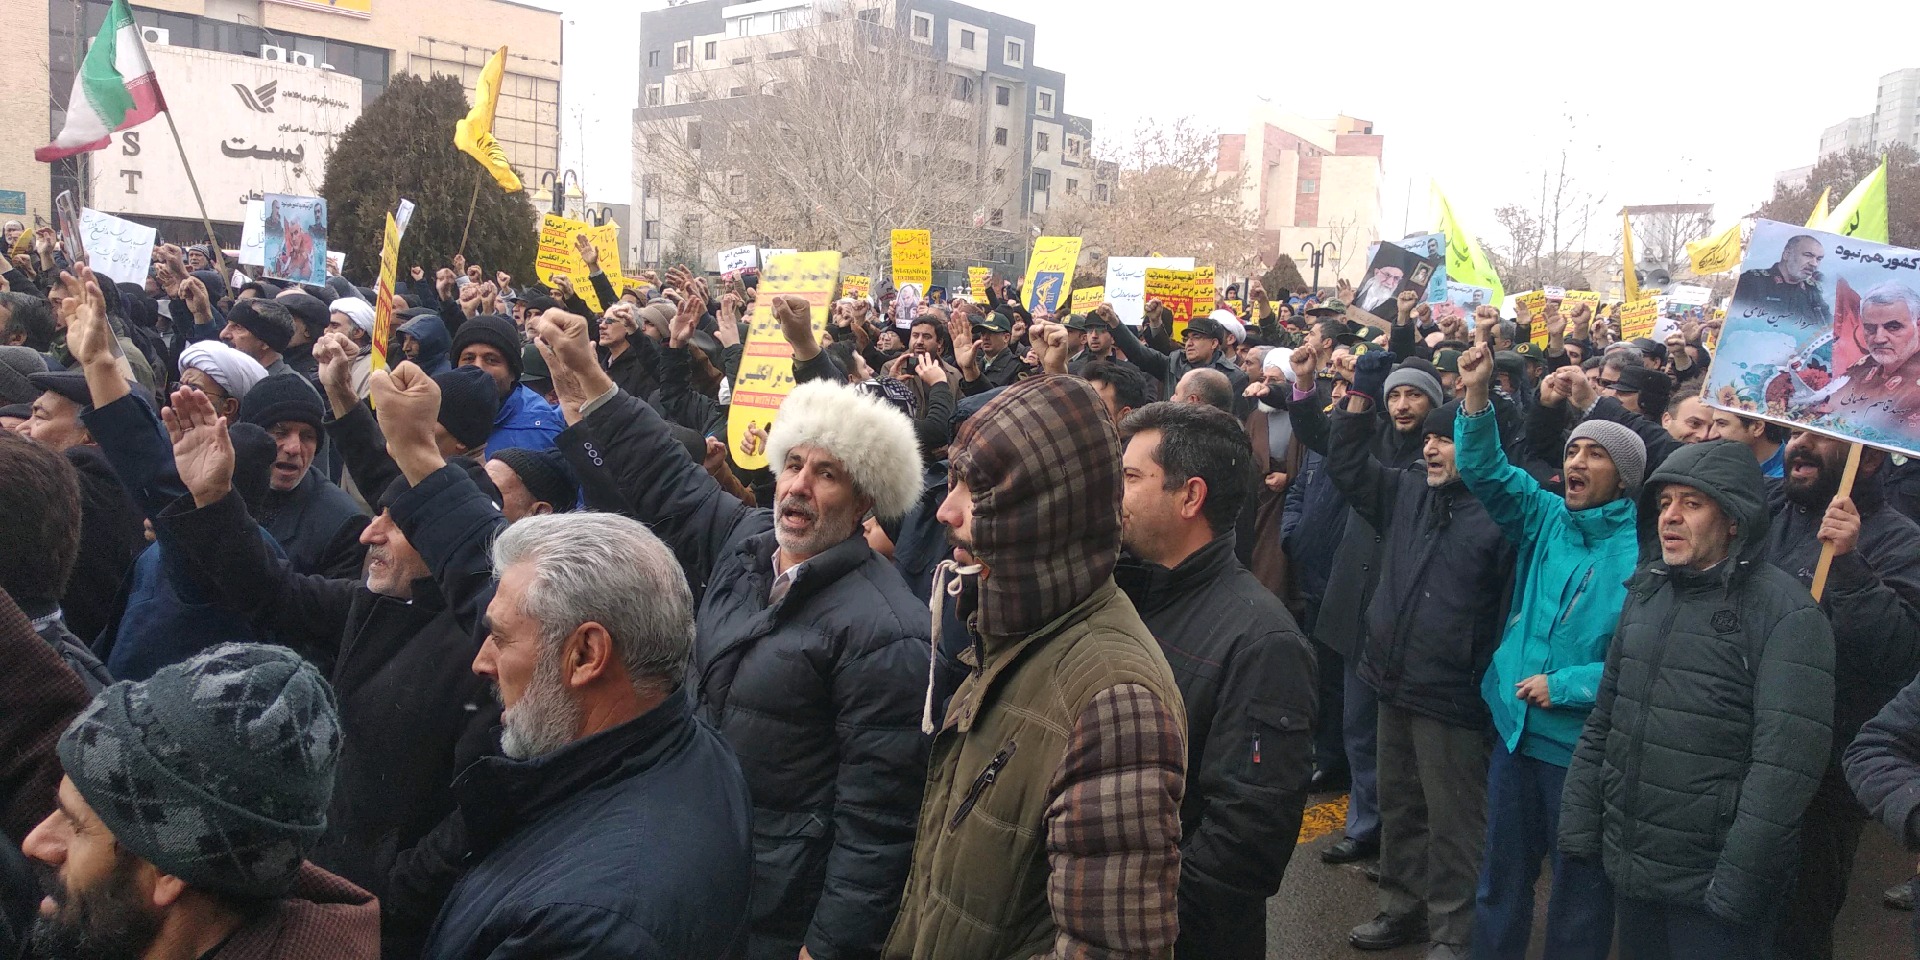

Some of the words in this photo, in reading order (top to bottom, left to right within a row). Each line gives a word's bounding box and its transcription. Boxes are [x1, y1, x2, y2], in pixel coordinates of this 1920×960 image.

[221, 137, 304, 178] پست
[544, 219, 567, 229] آمریکا
[541, 236, 565, 246] اسرائیل
[1835, 245, 1862, 261] نبود
[1860, 252, 1885, 264] هم
[1882, 256, 1920, 270] کشور
[1199, 269, 1213, 278] مرگ
[1073, 292, 1090, 301] آمریکا
[1200, 287, 1213, 296] مرگ
[1565, 292, 1581, 300] آمریکا
[1742, 306, 1769, 318] سلامی
[1766, 312, 1794, 328] حسین
[1792, 317, 1819, 330] سردار
[738, 364, 773, 385] انگلیس
[1840, 387, 1869, 414] سلیمانی
[1863, 399, 1893, 419] قاسم
